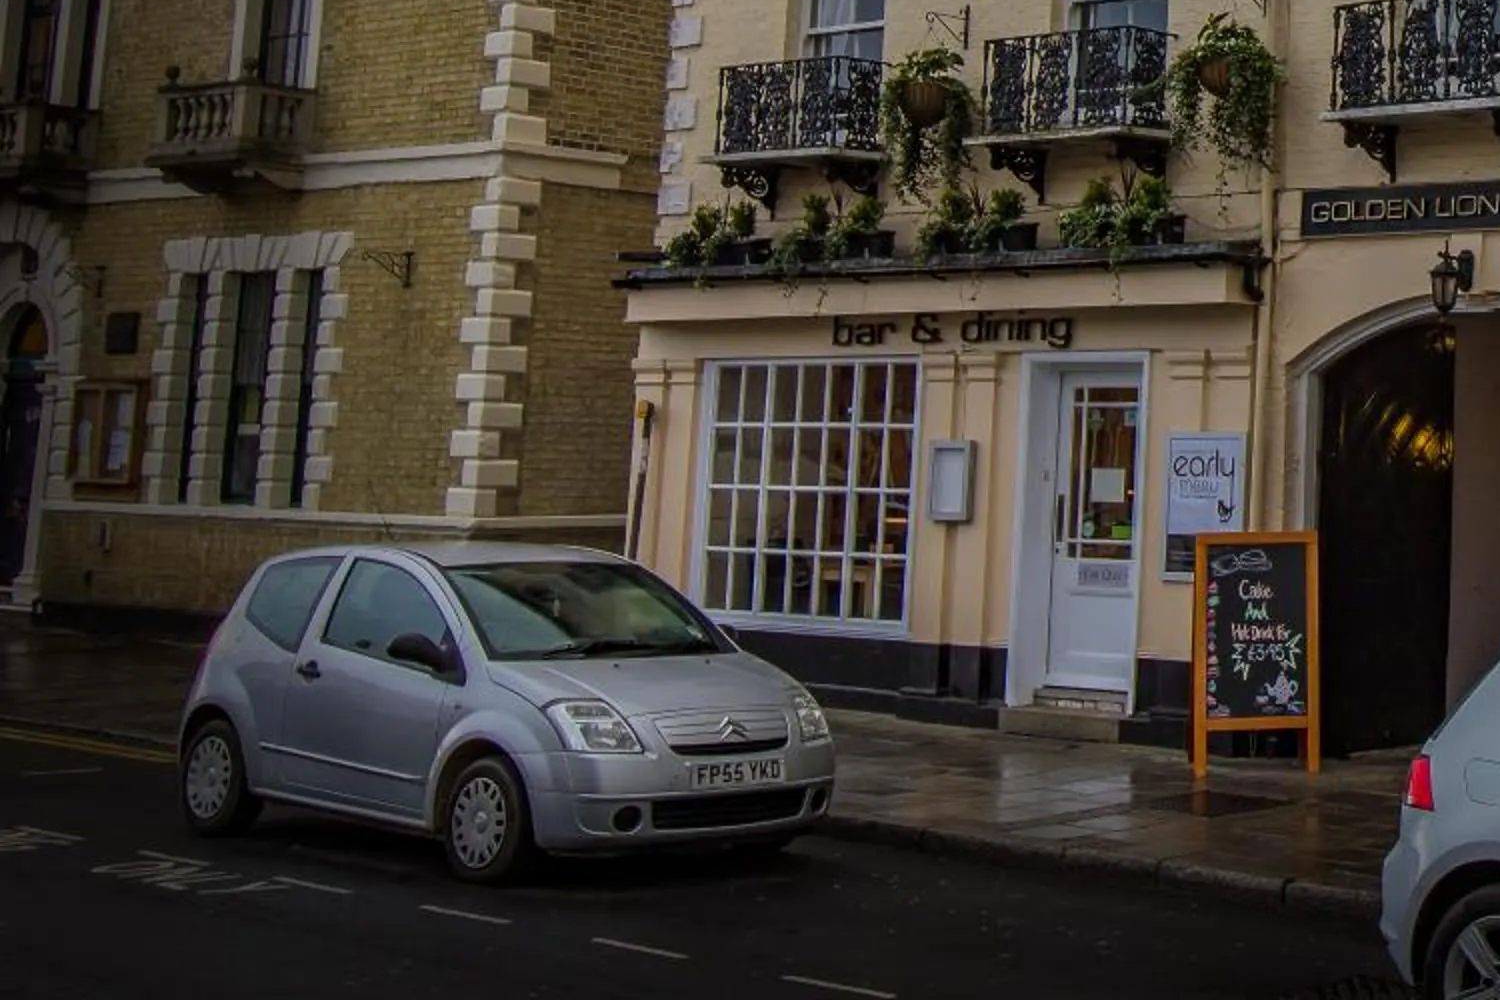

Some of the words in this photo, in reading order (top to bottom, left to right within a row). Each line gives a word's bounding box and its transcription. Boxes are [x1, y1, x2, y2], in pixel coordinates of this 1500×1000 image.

[1310, 197, 1426, 224] GOLDEN
[1434, 192, 1500, 218] LION
[832, 314, 897, 347] bar
[911, 313, 943, 344] &
[960, 310, 1074, 349] dining
[1173, 448, 1236, 497] early
[1238, 579, 1273, 600] Cake
[697, 762, 744, 785] FP55
[747, 759, 781, 781] YKD
